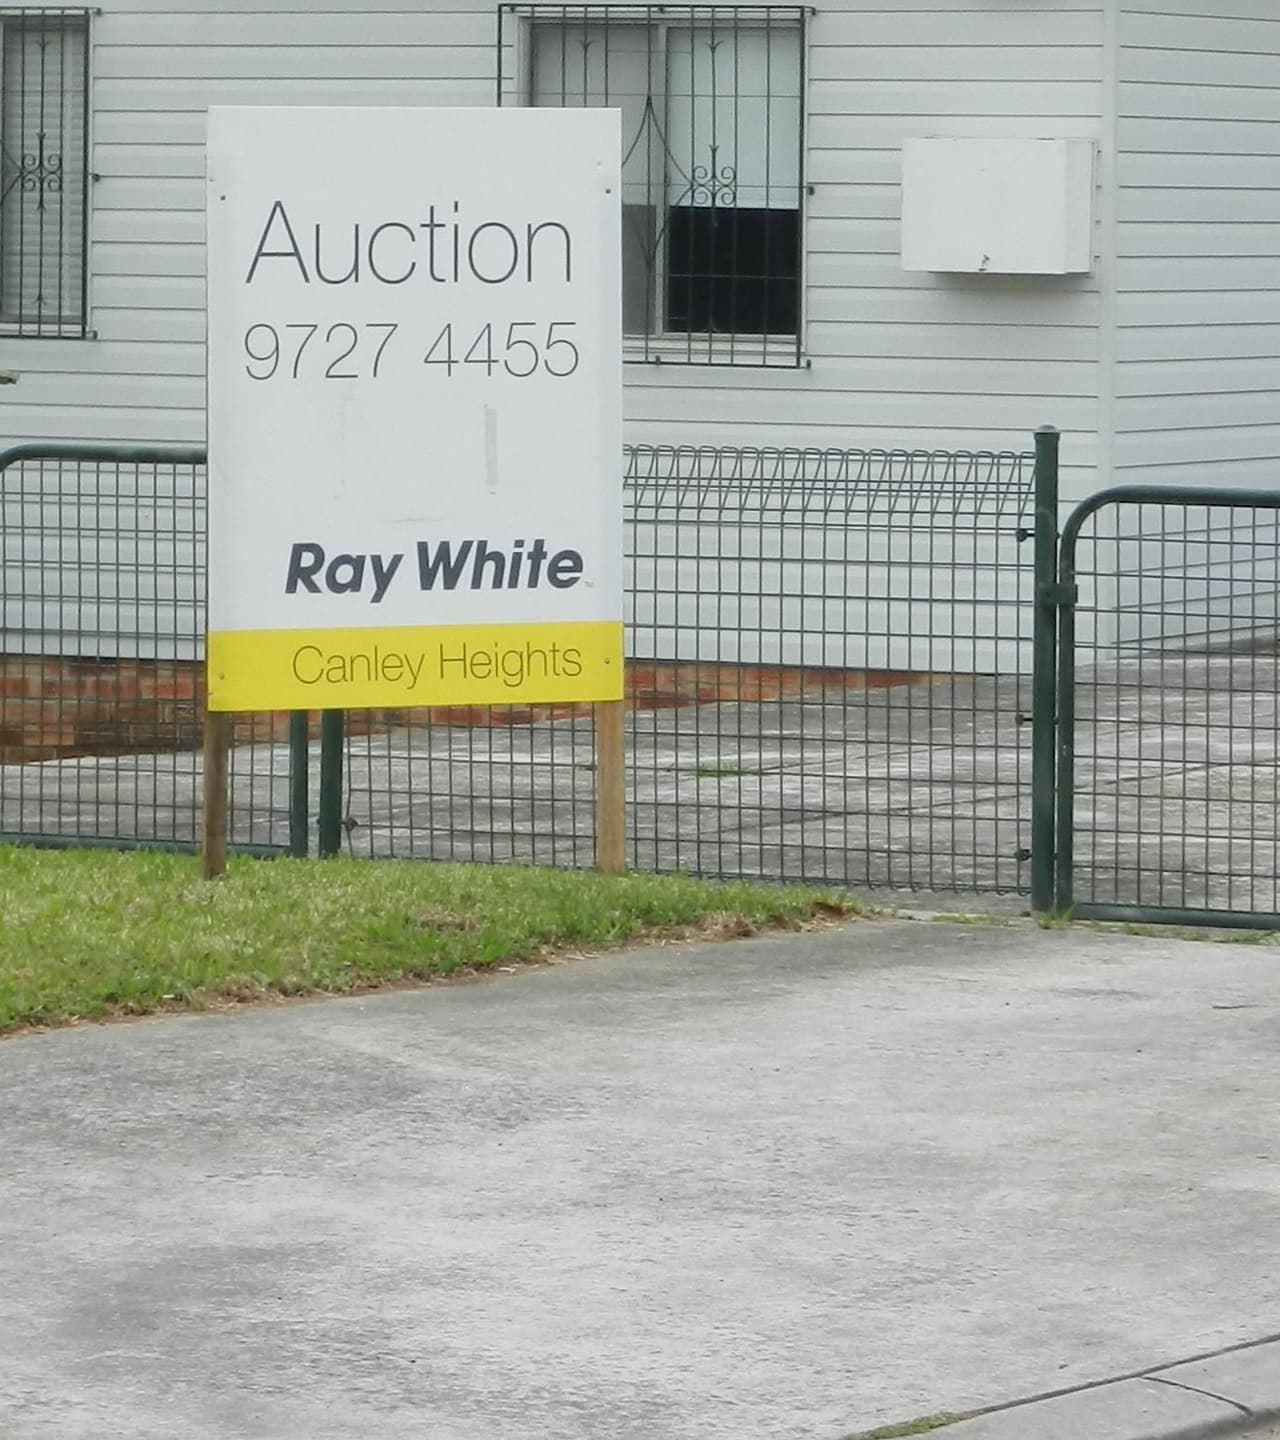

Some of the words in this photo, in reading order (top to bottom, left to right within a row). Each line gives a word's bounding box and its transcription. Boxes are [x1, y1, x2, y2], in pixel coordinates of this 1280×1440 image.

[245, 200, 572, 285] Auction
[244, 322, 399, 380] 9727
[423, 321, 580, 378] 4455
[284, 542, 405, 604] Ray
[416, 539, 584, 592] White
[291, 644, 426, 690] Canley
[438, 641, 583, 688] Heights
